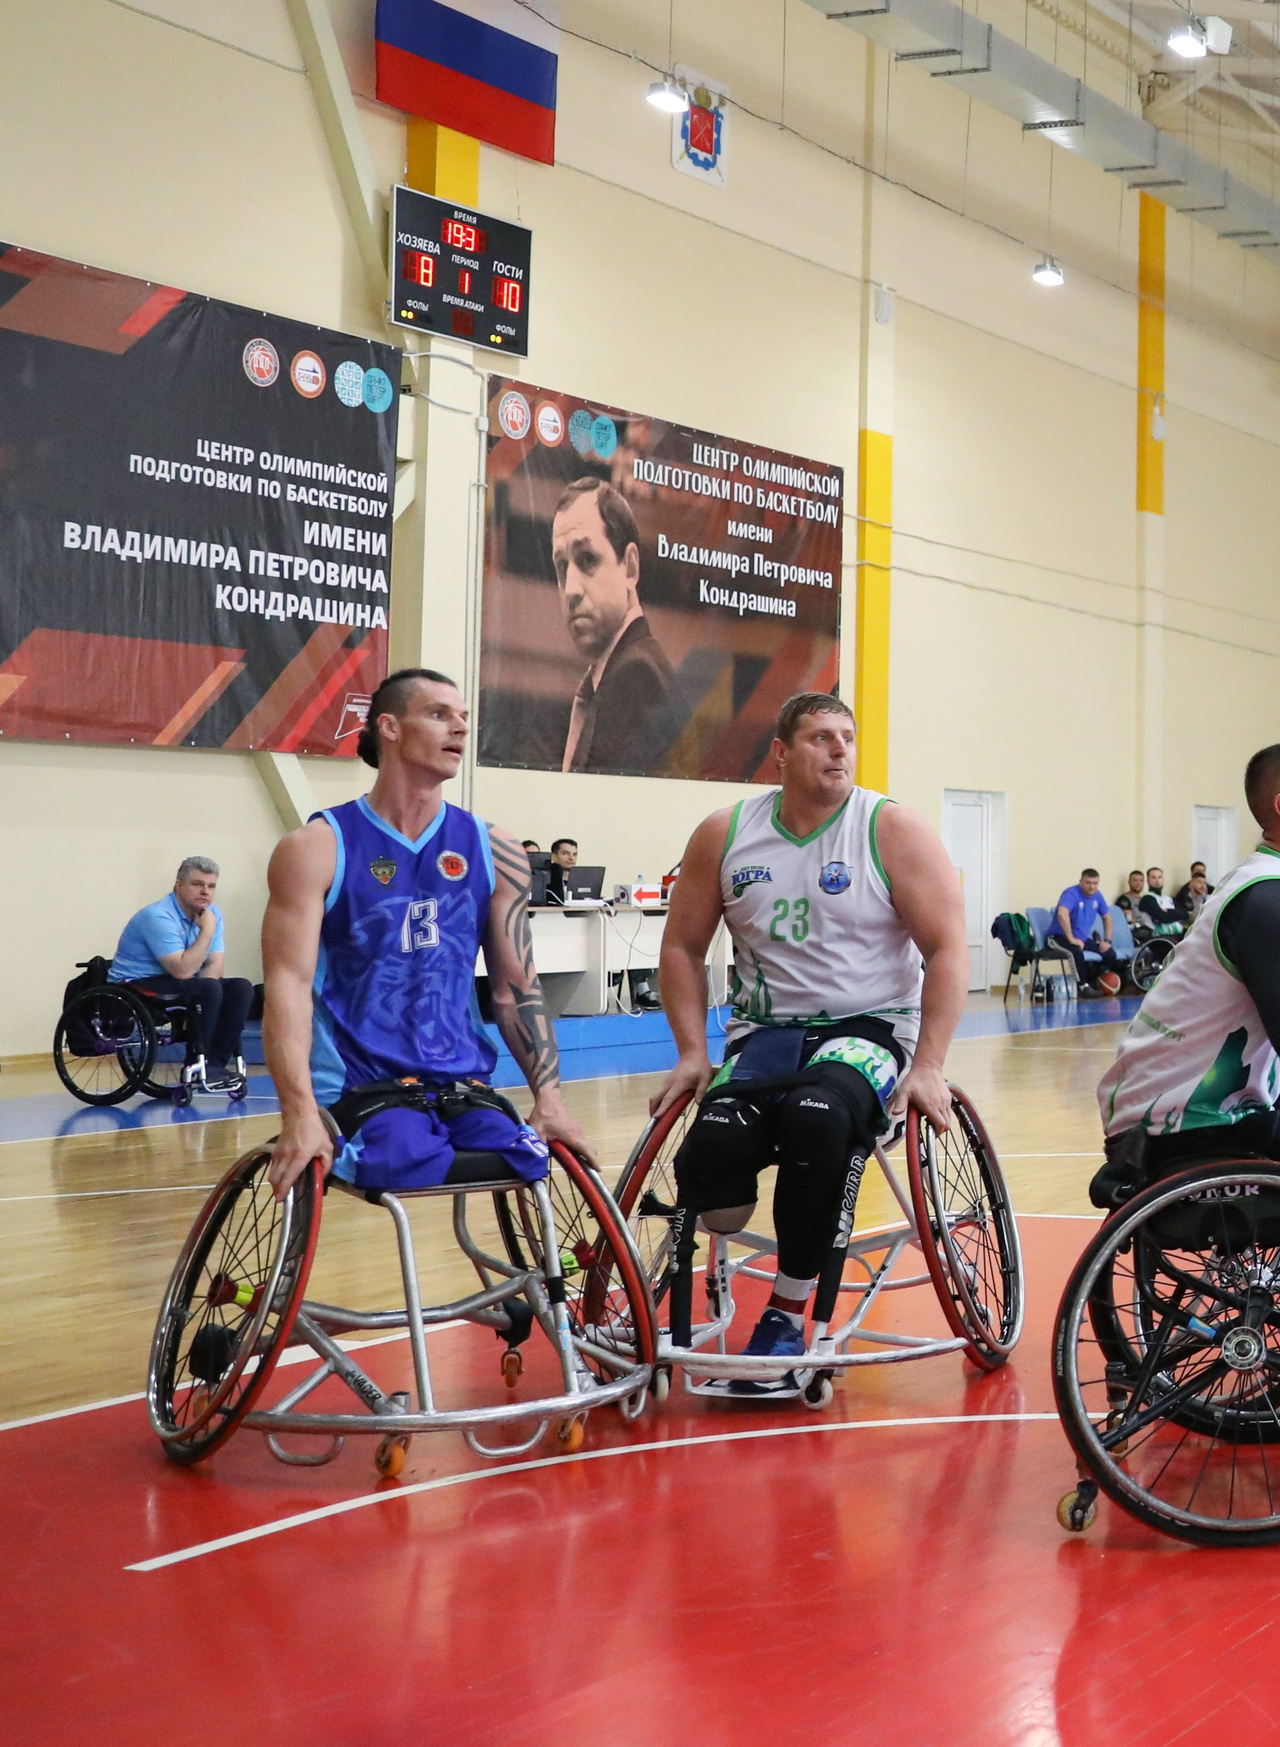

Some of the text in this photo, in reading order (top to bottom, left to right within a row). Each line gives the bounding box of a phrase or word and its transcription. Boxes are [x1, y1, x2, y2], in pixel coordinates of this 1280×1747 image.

[454, 210, 477, 224] ВРЕМЯ
[396, 231, 441, 255] ХОЗЯЕВА
[421, 256, 433, 287] 8
[451, 254, 479, 270] ПЕРИОД
[493, 260, 523, 280] ГОСТИ
[465, 272, 470, 294] 1
[503, 282, 520, 313] 10
[406, 299, 429, 312] ФОЛЫ
[442, 294, 485, 313] ВРЕМЯ АТАКИ
[496, 324, 516, 336] ФОЛЫ
[197, 439, 388, 494] ЦЕНТР ОЛИМПИЙСКОЙ
[693, 443, 840, 498] ЦЕНТР ОЛИМПИЙСКОЙ
[130, 455, 388, 519] ПОДГОТОВКИ ПО БАСКЕТБОЛУ
[633, 458, 839, 528] ПОДГОТОВКИ ПО БАСКЕТБОЛУ
[303, 520, 387, 557] ИМЕНИ
[727, 519, 773, 544] имени
[63, 520, 388, 594] ВЛАДИМИРА ПЕТРОВИЧА
[657, 533, 834, 589] Владимира Петровича
[215, 584, 388, 630] КОНДРАШИНА
[699, 579, 797, 618] Кондрашина
[731, 870, 773, 886] ЮГРА
[401, 898, 440, 953] 13
[770, 897, 809, 943] 23
[799, 1098, 830, 1110] MIKASA
[718, 1258, 727, 1293] WIND
[864, 1263, 890, 1299] WIND
